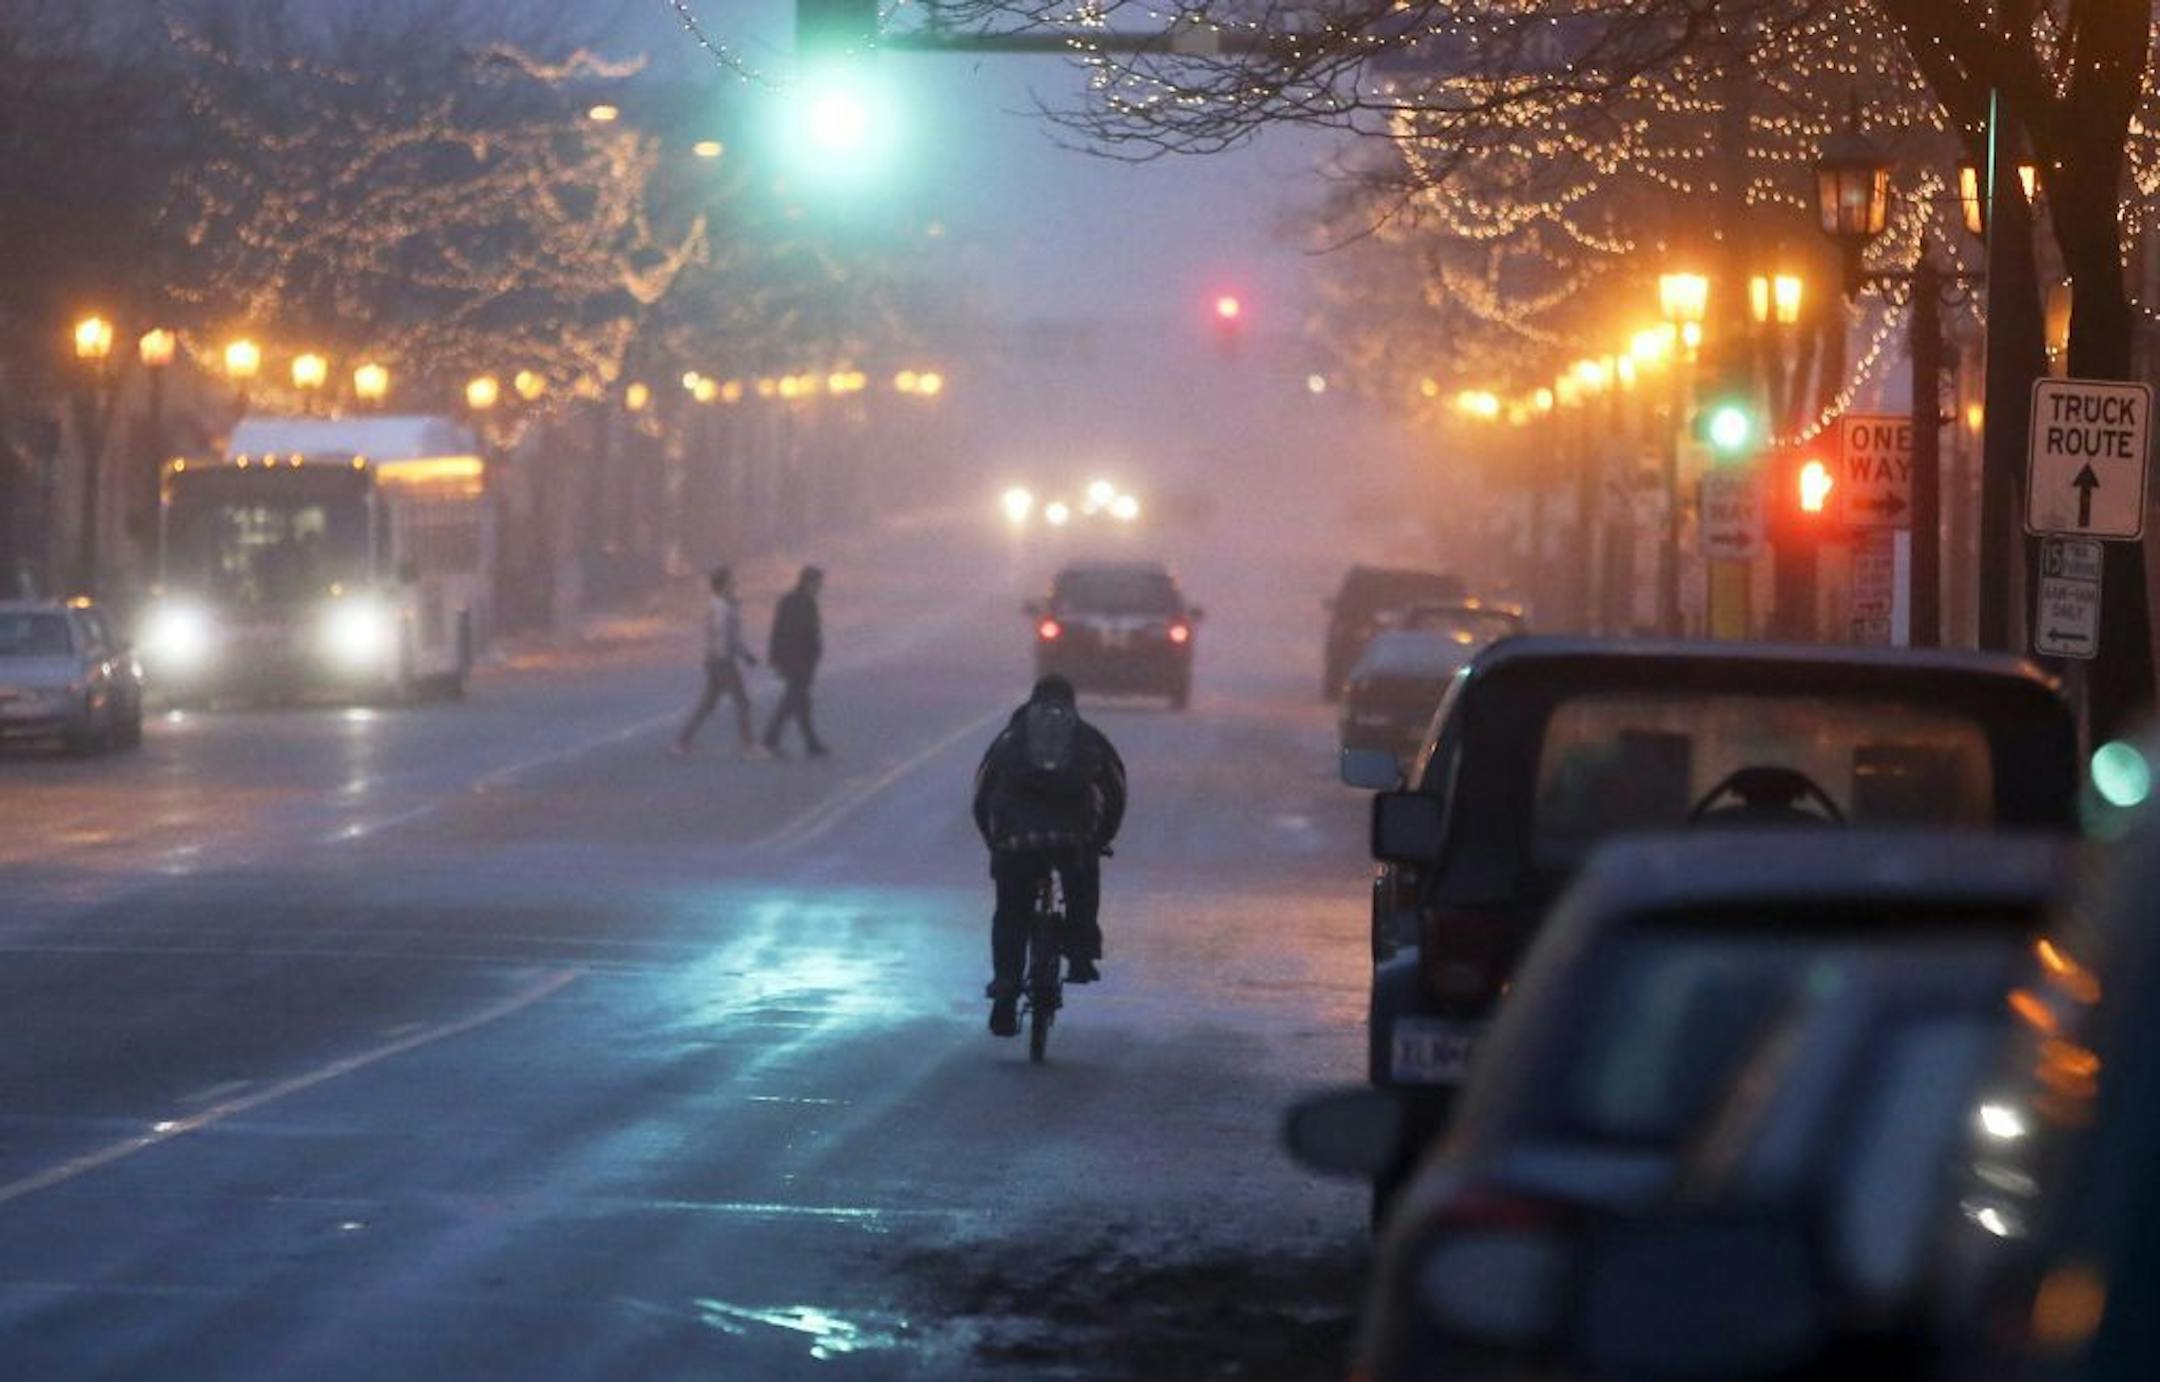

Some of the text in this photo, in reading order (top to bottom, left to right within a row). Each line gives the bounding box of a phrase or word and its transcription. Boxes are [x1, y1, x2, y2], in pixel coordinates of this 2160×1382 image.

[2049, 393, 2136, 426] TRUCK
[1851, 424, 1914, 452] ONE
[2047, 426, 2134, 458] ROUTE
[1850, 457, 1913, 483] WAY
[1709, 502, 1754, 521] WAY
